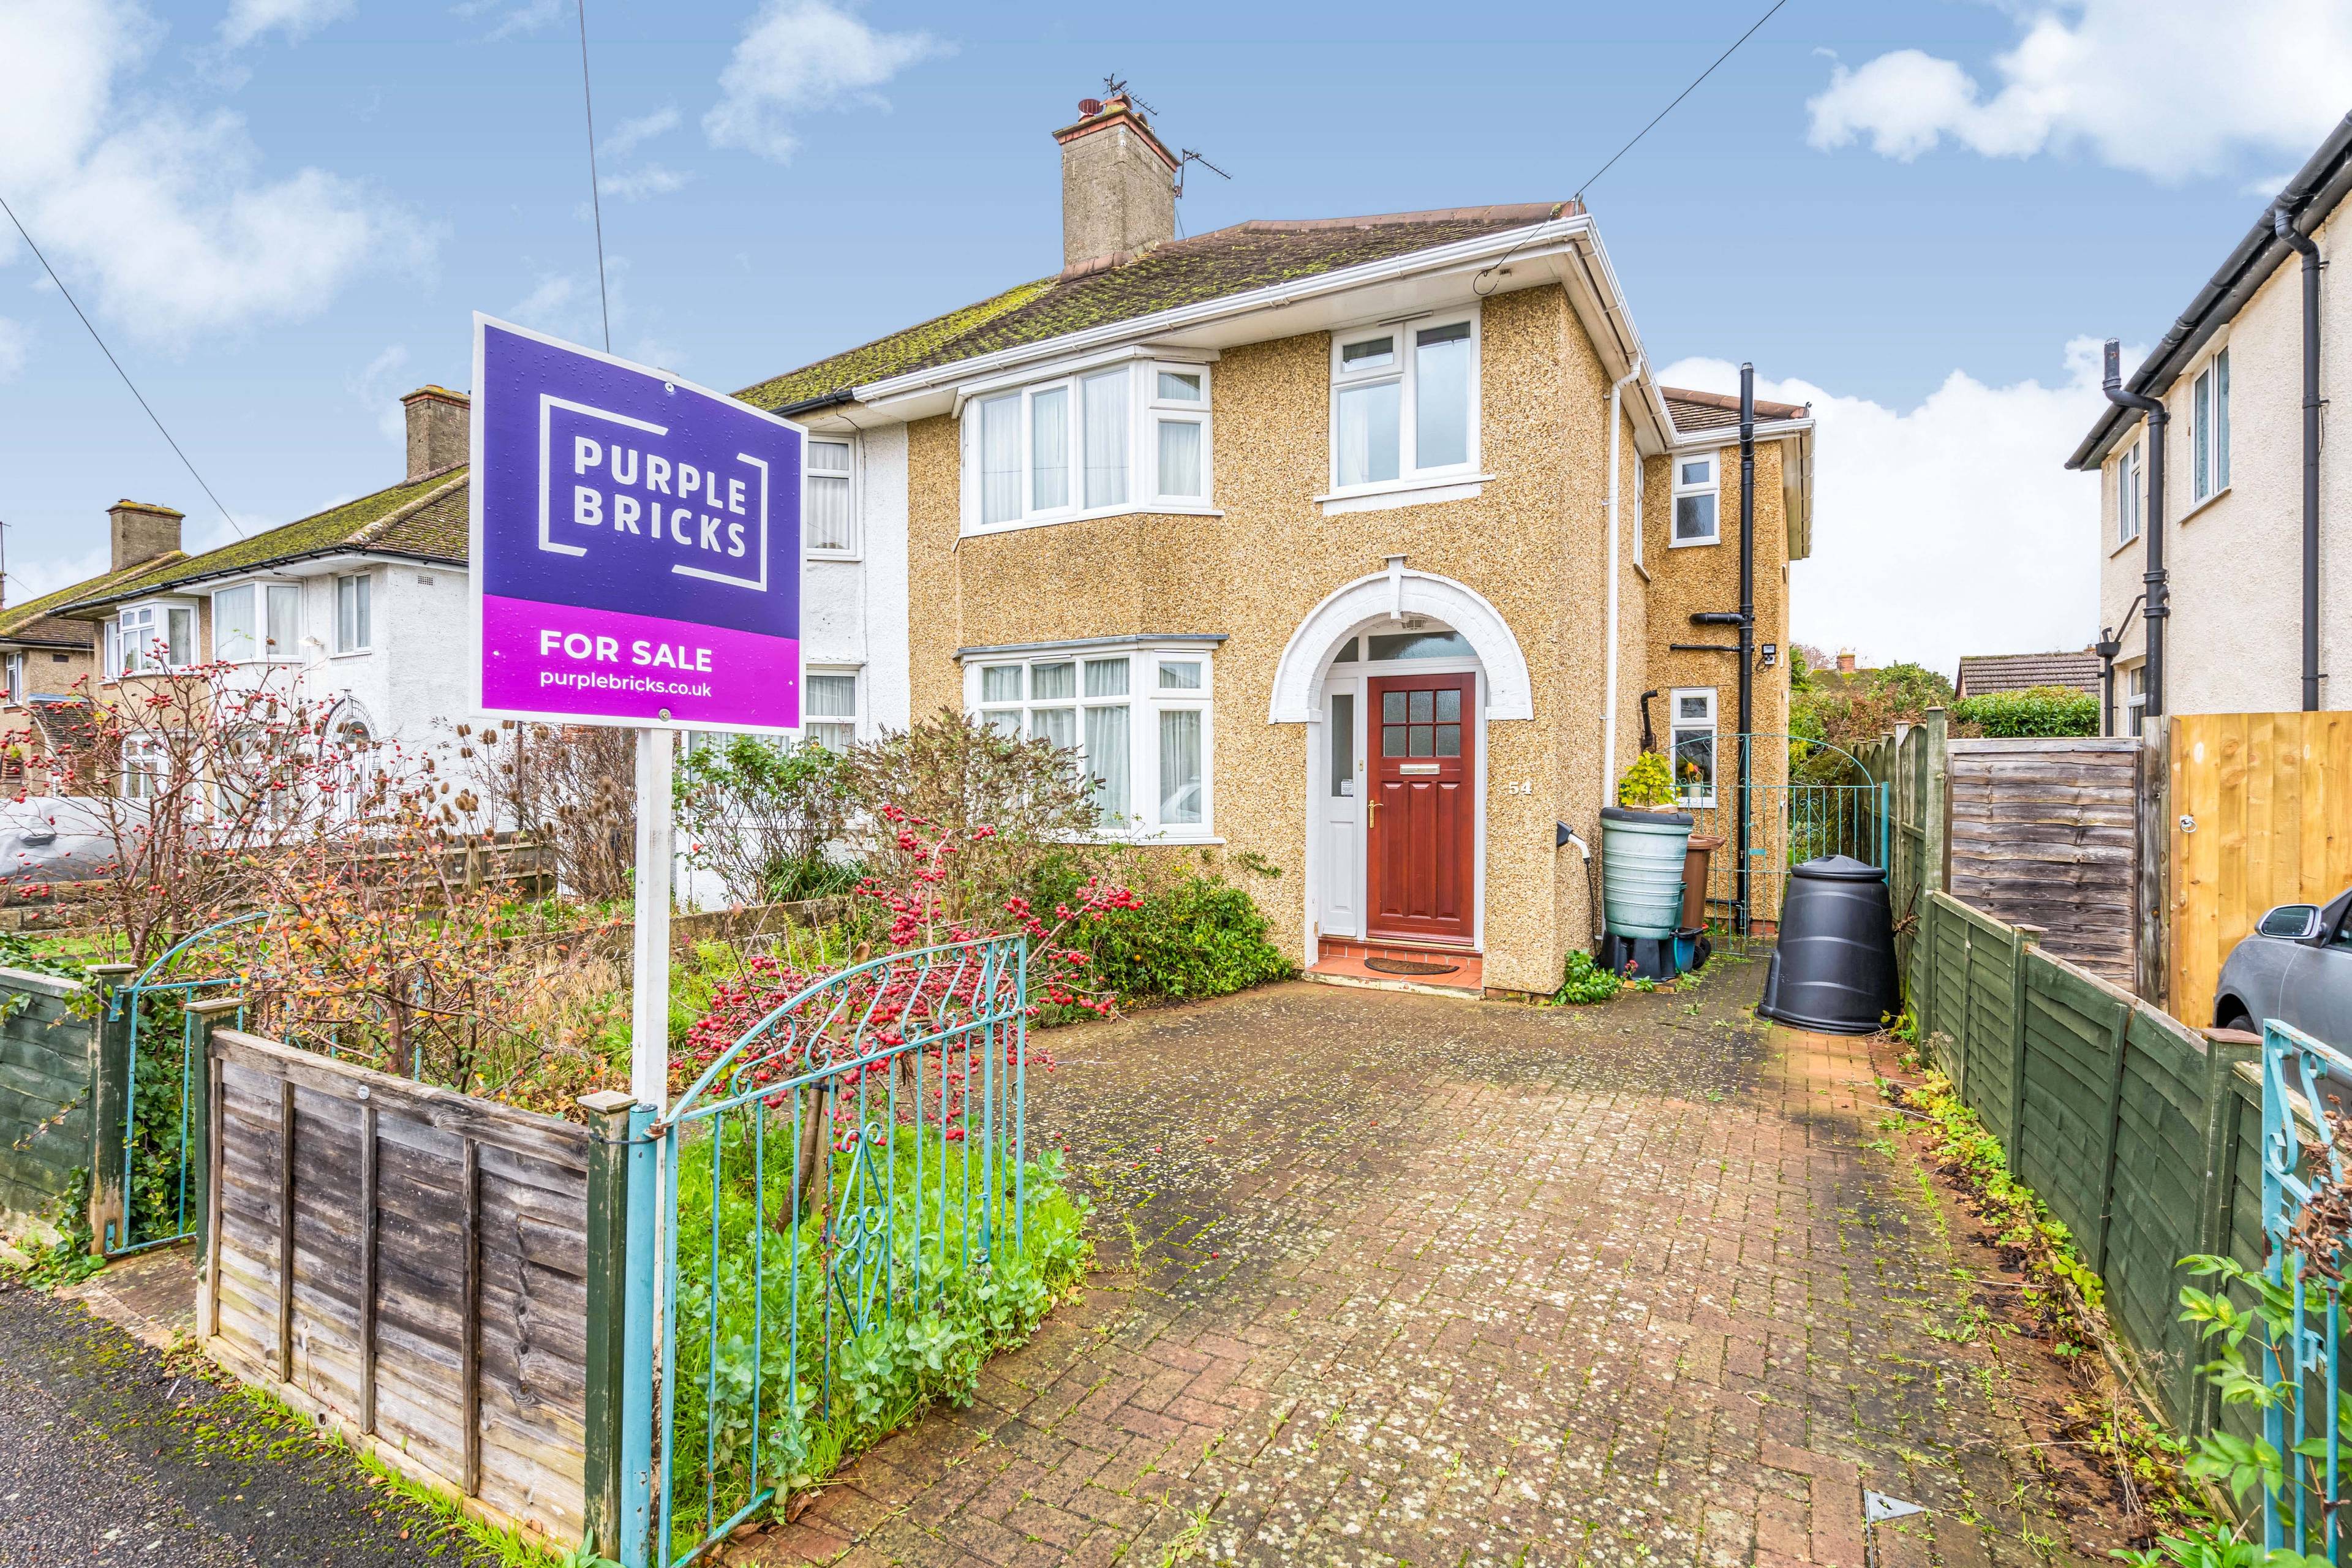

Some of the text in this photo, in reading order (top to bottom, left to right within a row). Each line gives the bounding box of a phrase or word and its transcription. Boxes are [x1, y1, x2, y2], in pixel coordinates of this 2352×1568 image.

[574, 435, 746, 516] PURPLE
[574, 485, 746, 557] BRICKS
[540, 629, 713, 673] FOR SALE
[540, 671, 712, 697] purplebricks.co.uk
[1509, 781, 1532, 795] 54
